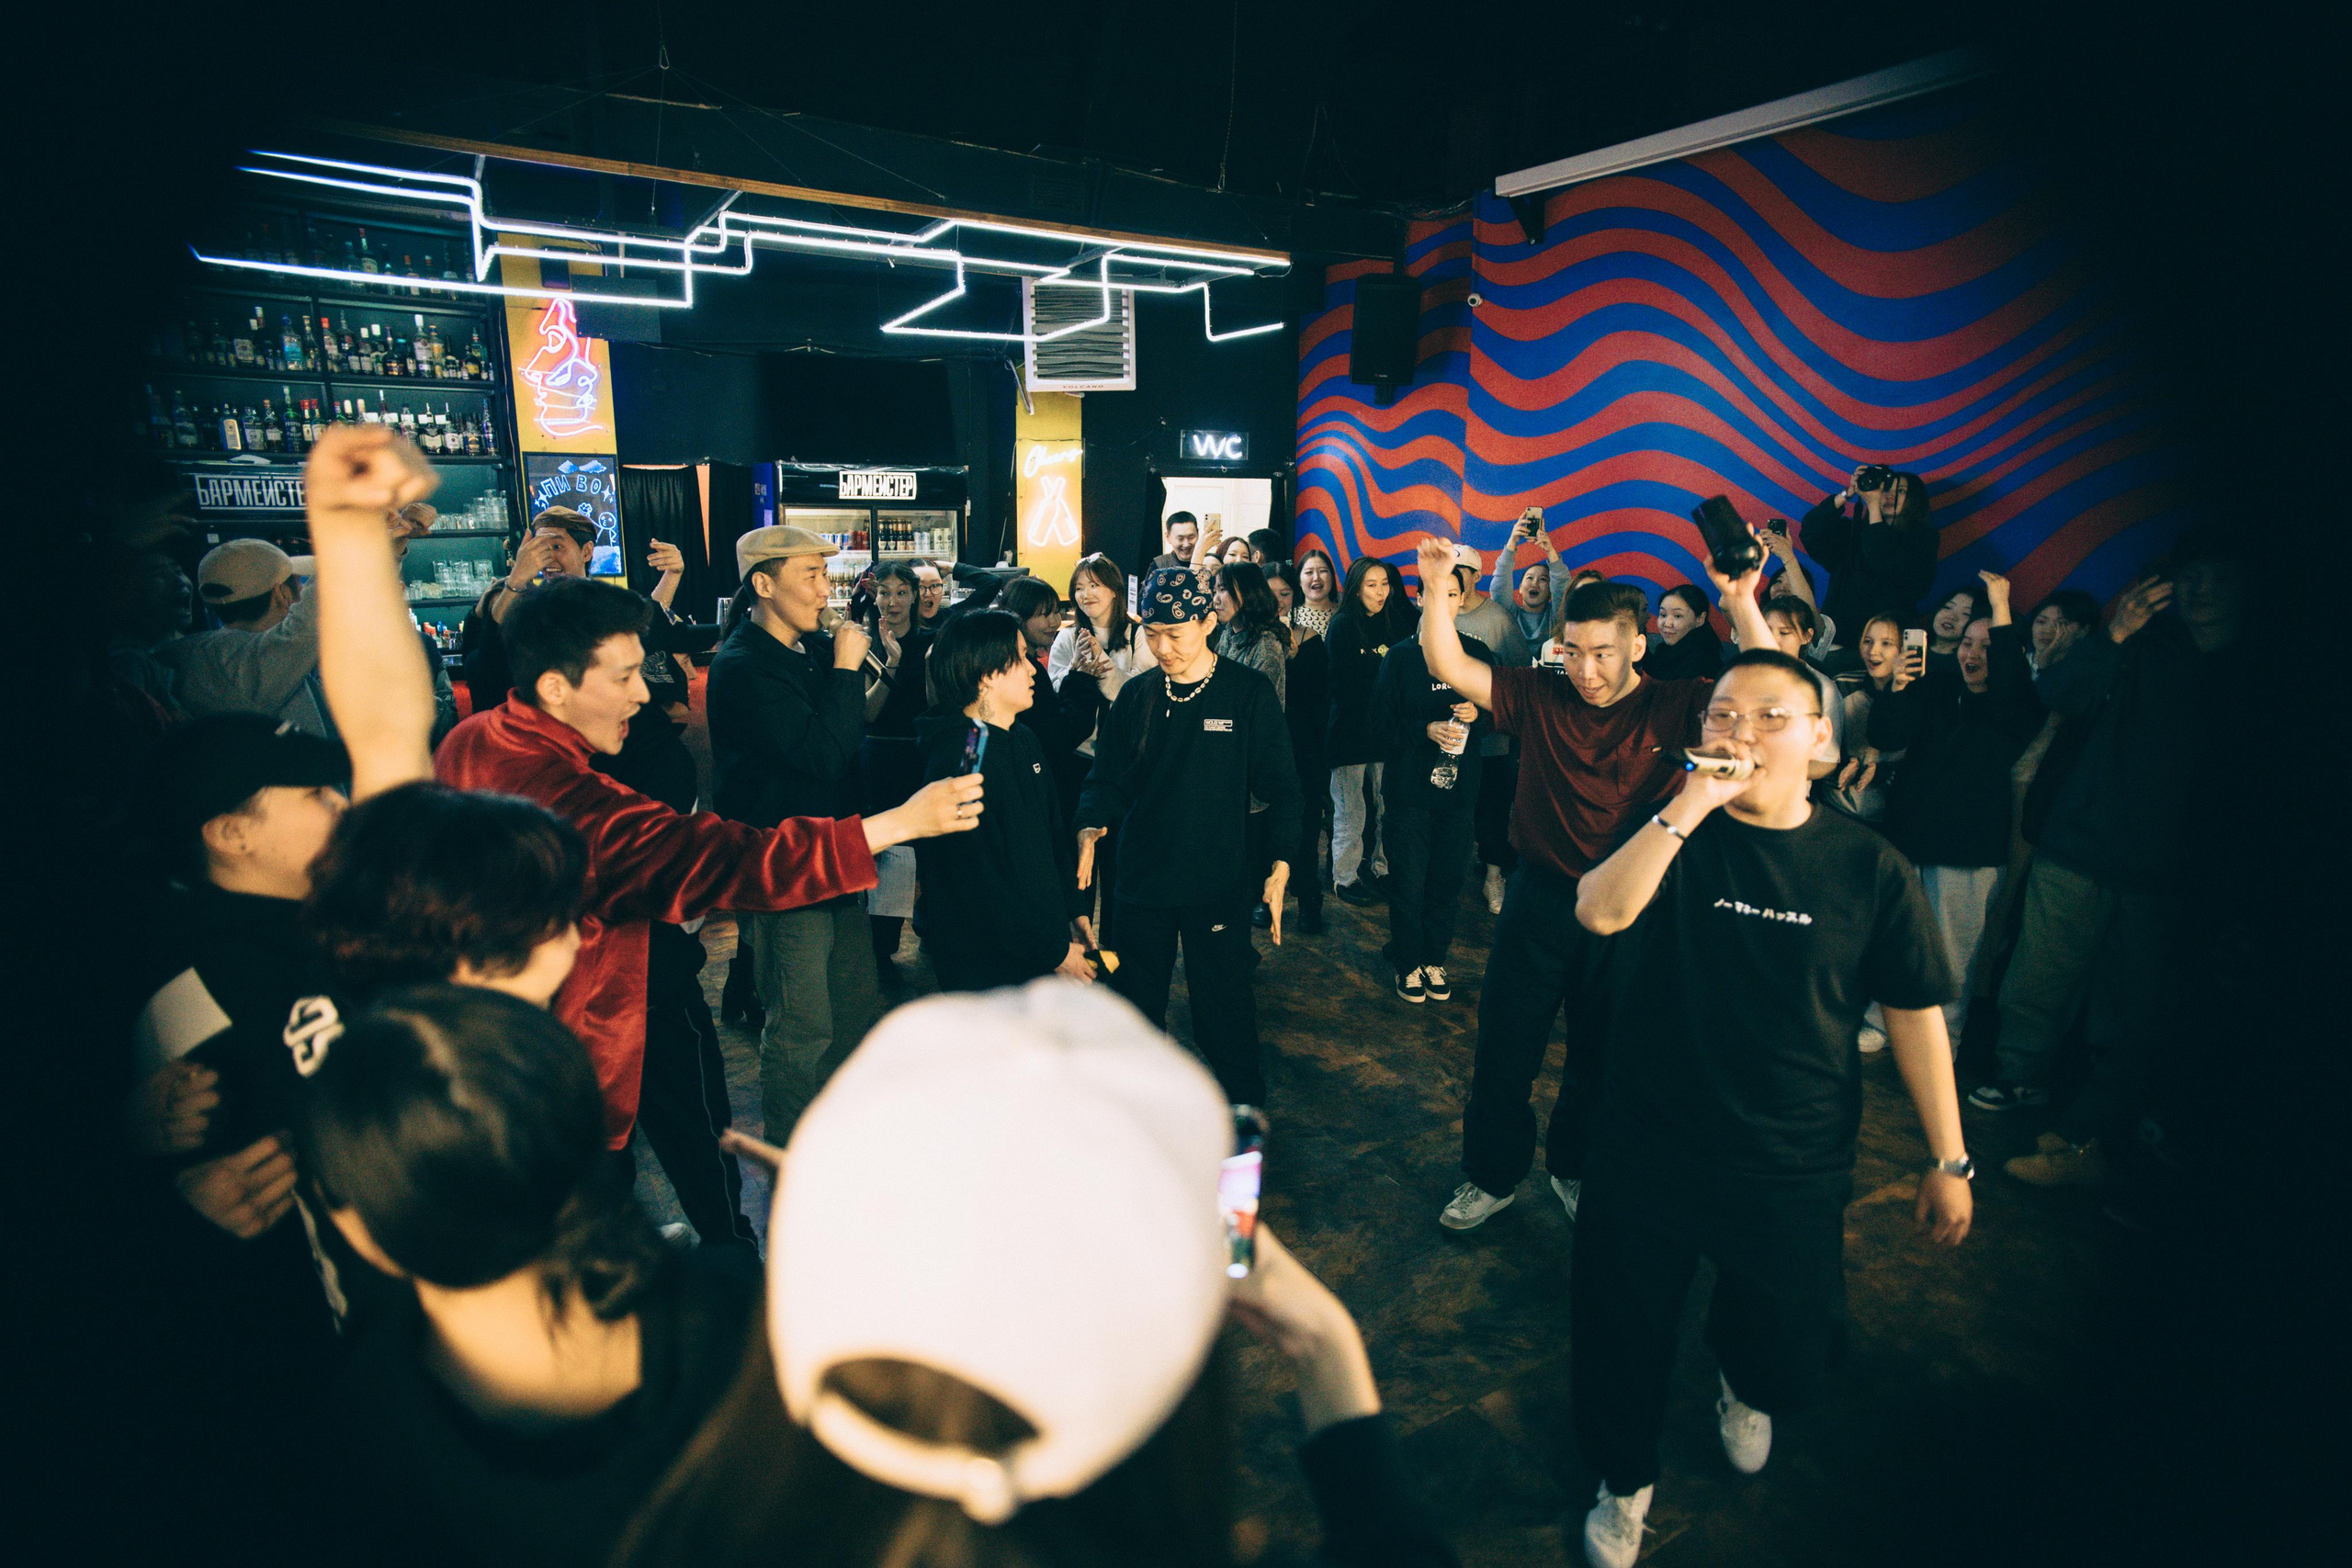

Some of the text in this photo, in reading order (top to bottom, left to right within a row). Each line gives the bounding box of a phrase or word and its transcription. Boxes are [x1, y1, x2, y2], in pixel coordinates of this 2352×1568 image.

[1193, 434, 1242, 459] WC
[195, 474, 309, 507] БАРМЕЙСТЕ
[839, 471, 914, 497] БАРМЕЙСТЕР
